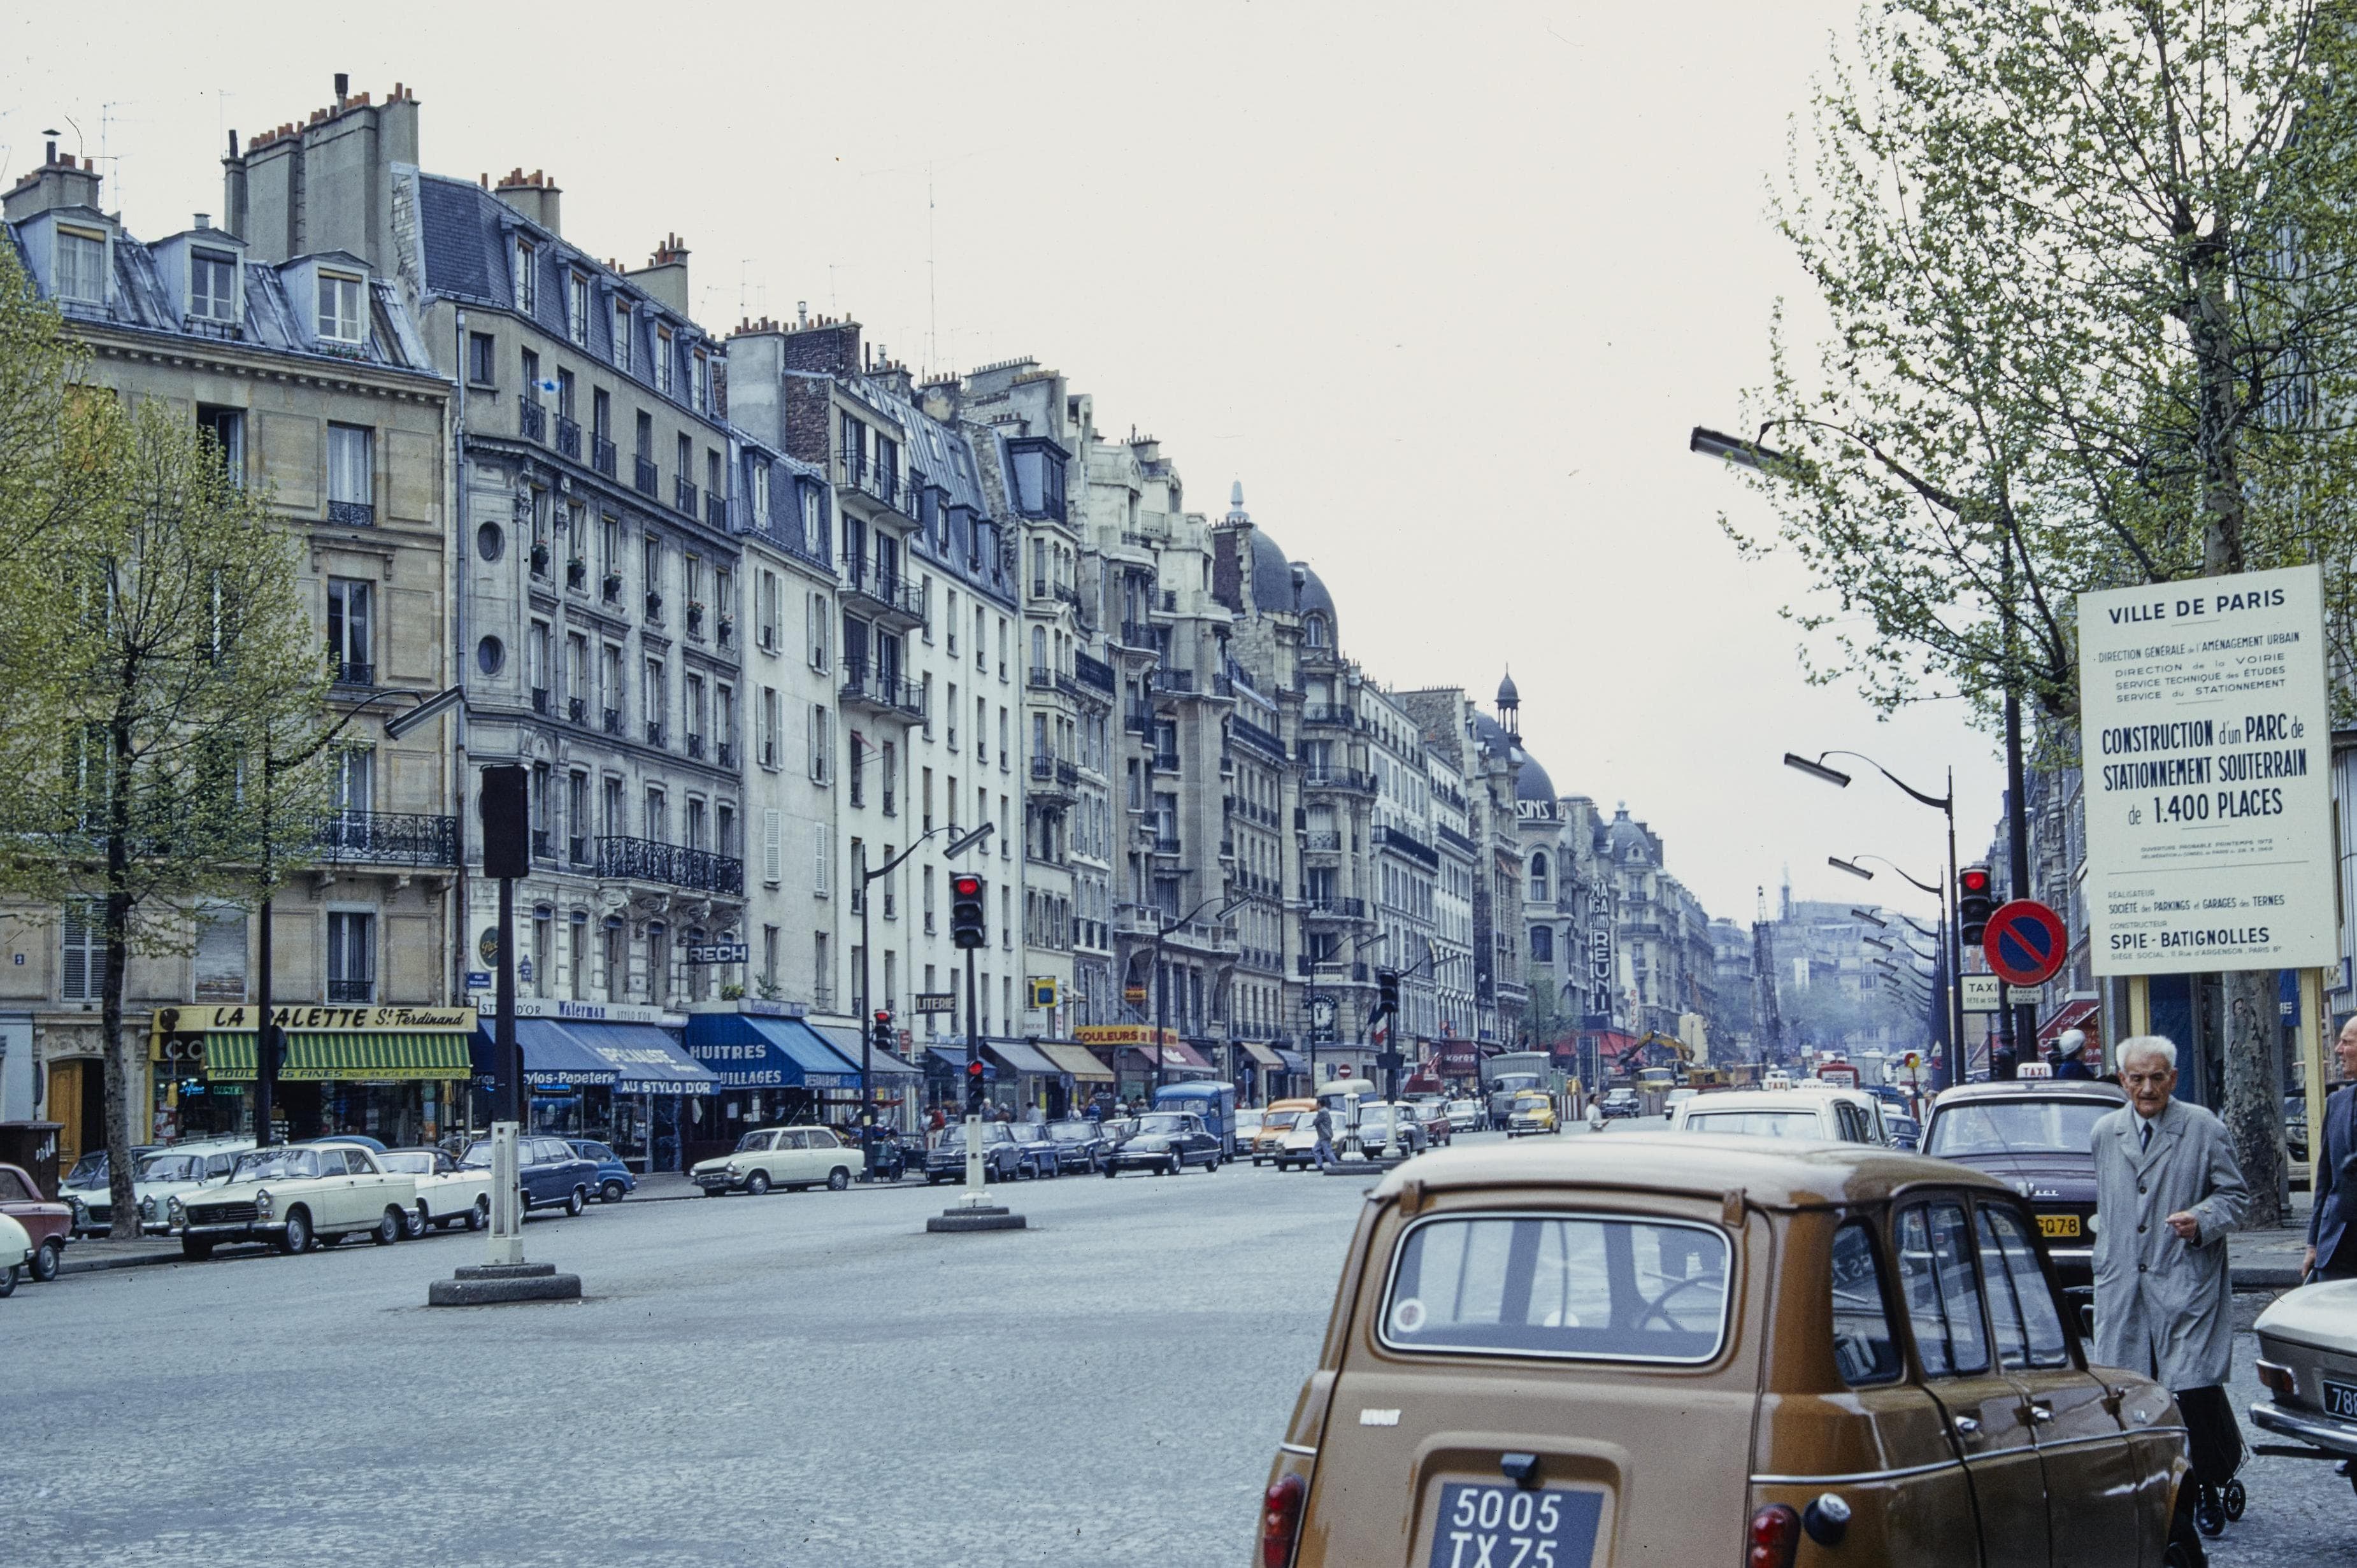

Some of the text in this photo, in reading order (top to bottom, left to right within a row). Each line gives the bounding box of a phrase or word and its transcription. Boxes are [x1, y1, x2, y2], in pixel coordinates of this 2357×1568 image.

[2109, 588, 2285, 624] VILLE DE PARIS
[2098, 648, 2142, 663] DIRECTION
[2267, 631, 2300, 645] URBAIN
[2115, 664, 2182, 678] DIRECTION
[2215, 659, 2225, 667] la
[2235, 652, 2286, 665] VOIRIE
[2116, 678, 2161, 690] SERVICE
[2165, 673, 2222, 685] TECHNIQUE
[2244, 666, 2286, 678] ÉTUDES
[2116, 690, 2161, 703] SERVICE
[2195, 678, 2286, 695] STATIONNEMENT
[2102, 713, 2304, 755] CONSTRUCTION d'un PARC de
[2103, 748, 2307, 792] STATIONNEMENT SOUTERRAIN
[2128, 788, 2283, 825] de 1.400 PLACES
[2153, 899, 2191, 912] PARKINGS
[2202, 897, 2237, 909] GARAGES
[2252, 894, 2286, 906] TERNES
[2109, 920, 2168, 930] CONSTRUCTEUR
[2110, 933, 2148, 950] SPIE
[2160, 927, 2270, 948] BATIGNOLLES
[689, 946, 746, 962] RECH
[1968, 983, 1998, 992] TAXI
[517, 1004, 541, 1015] D'OR
[917, 997, 955, 1011] LITERIE
[214, 1007, 245, 1027] LA
[395, 1008, 465, 1026] Ferdinand
[689, 1044, 767, 1060] HUITRES
[299, 1069, 343, 1078] FINES
[2023, 1067, 2047, 1077] TAXI
[622, 1080, 711, 1094] AU STYLO D'OR
[1768, 1082, 1787, 1092] TAXI
[1453, 1488, 1562, 1534] 5005
[1450, 1531, 1558, 1568] TX 75
